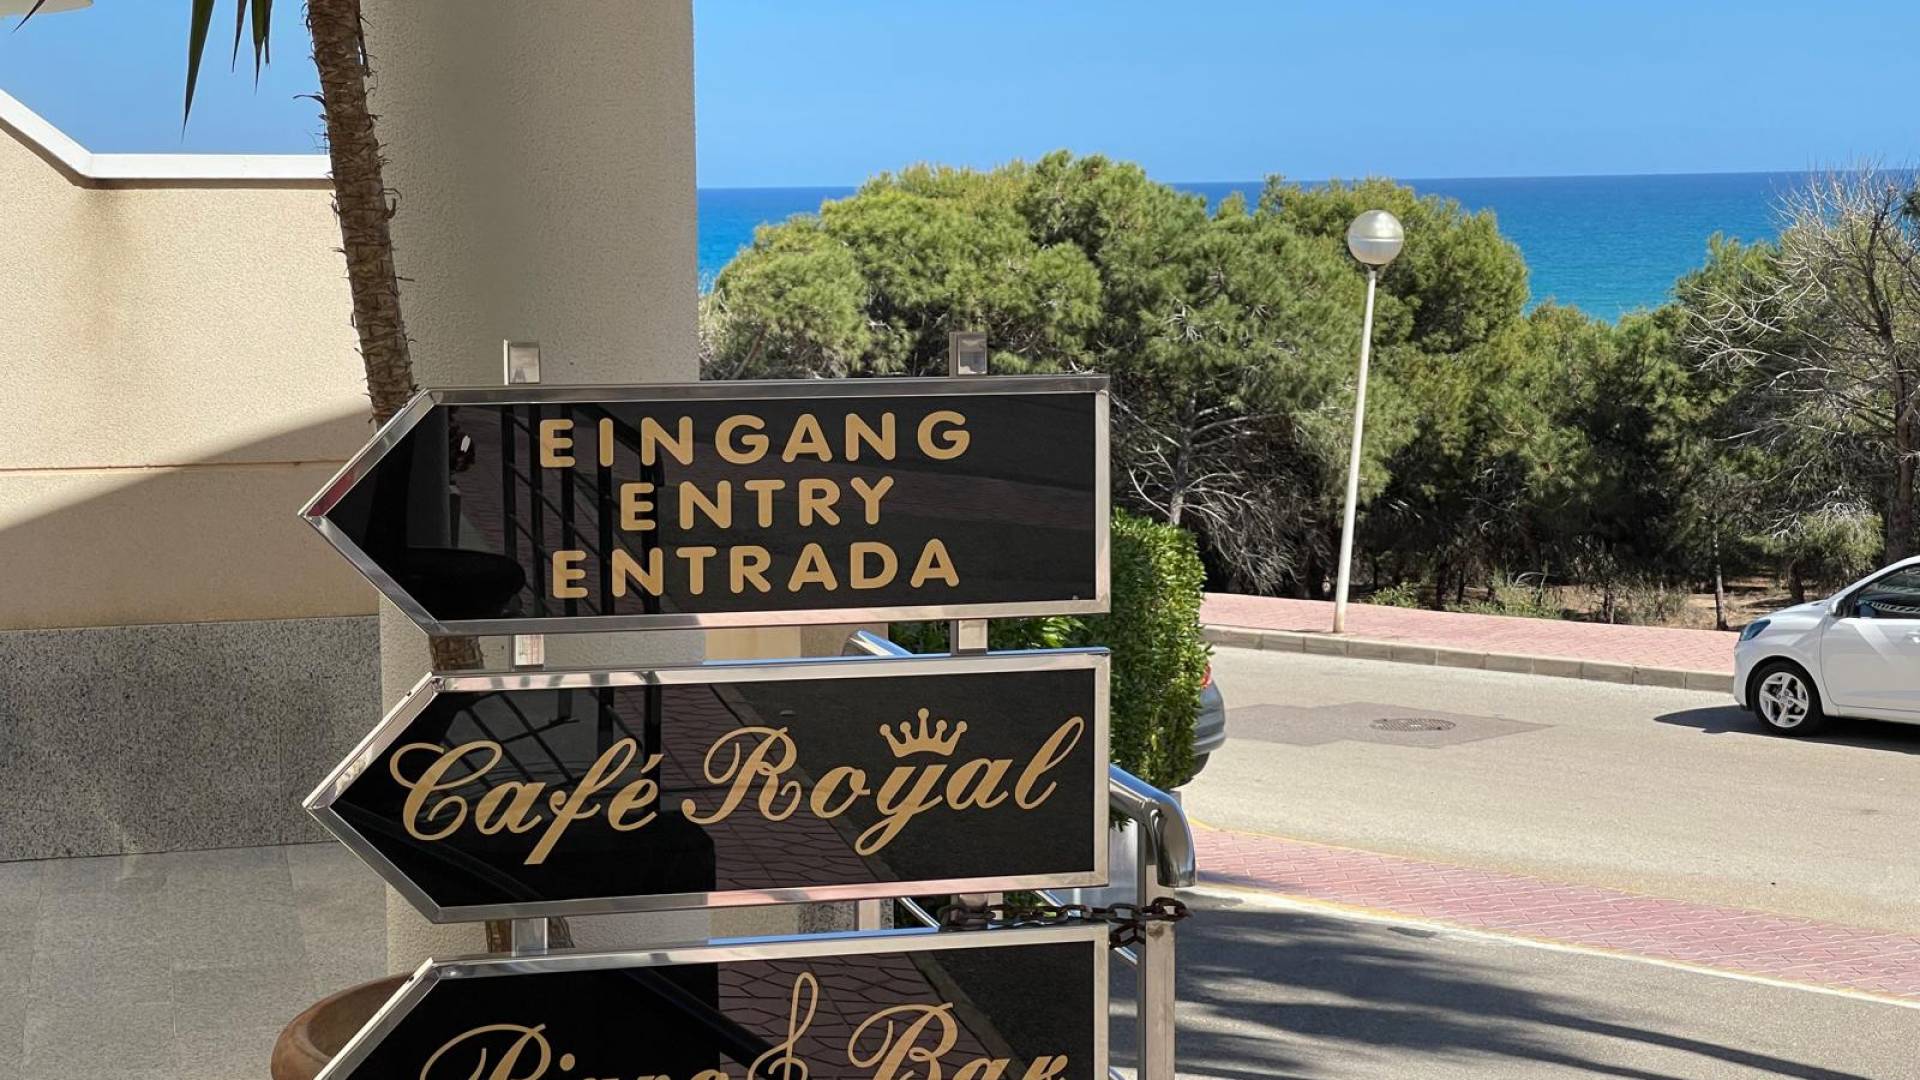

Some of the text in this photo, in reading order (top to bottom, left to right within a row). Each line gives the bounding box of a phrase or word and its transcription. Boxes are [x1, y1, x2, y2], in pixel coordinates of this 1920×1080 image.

[539, 410, 970, 468] EINGANG
[620, 475, 893, 532] ENTRY
[552, 539, 960, 599] ENTRADA
[389, 716, 1085, 865] Café Royal
